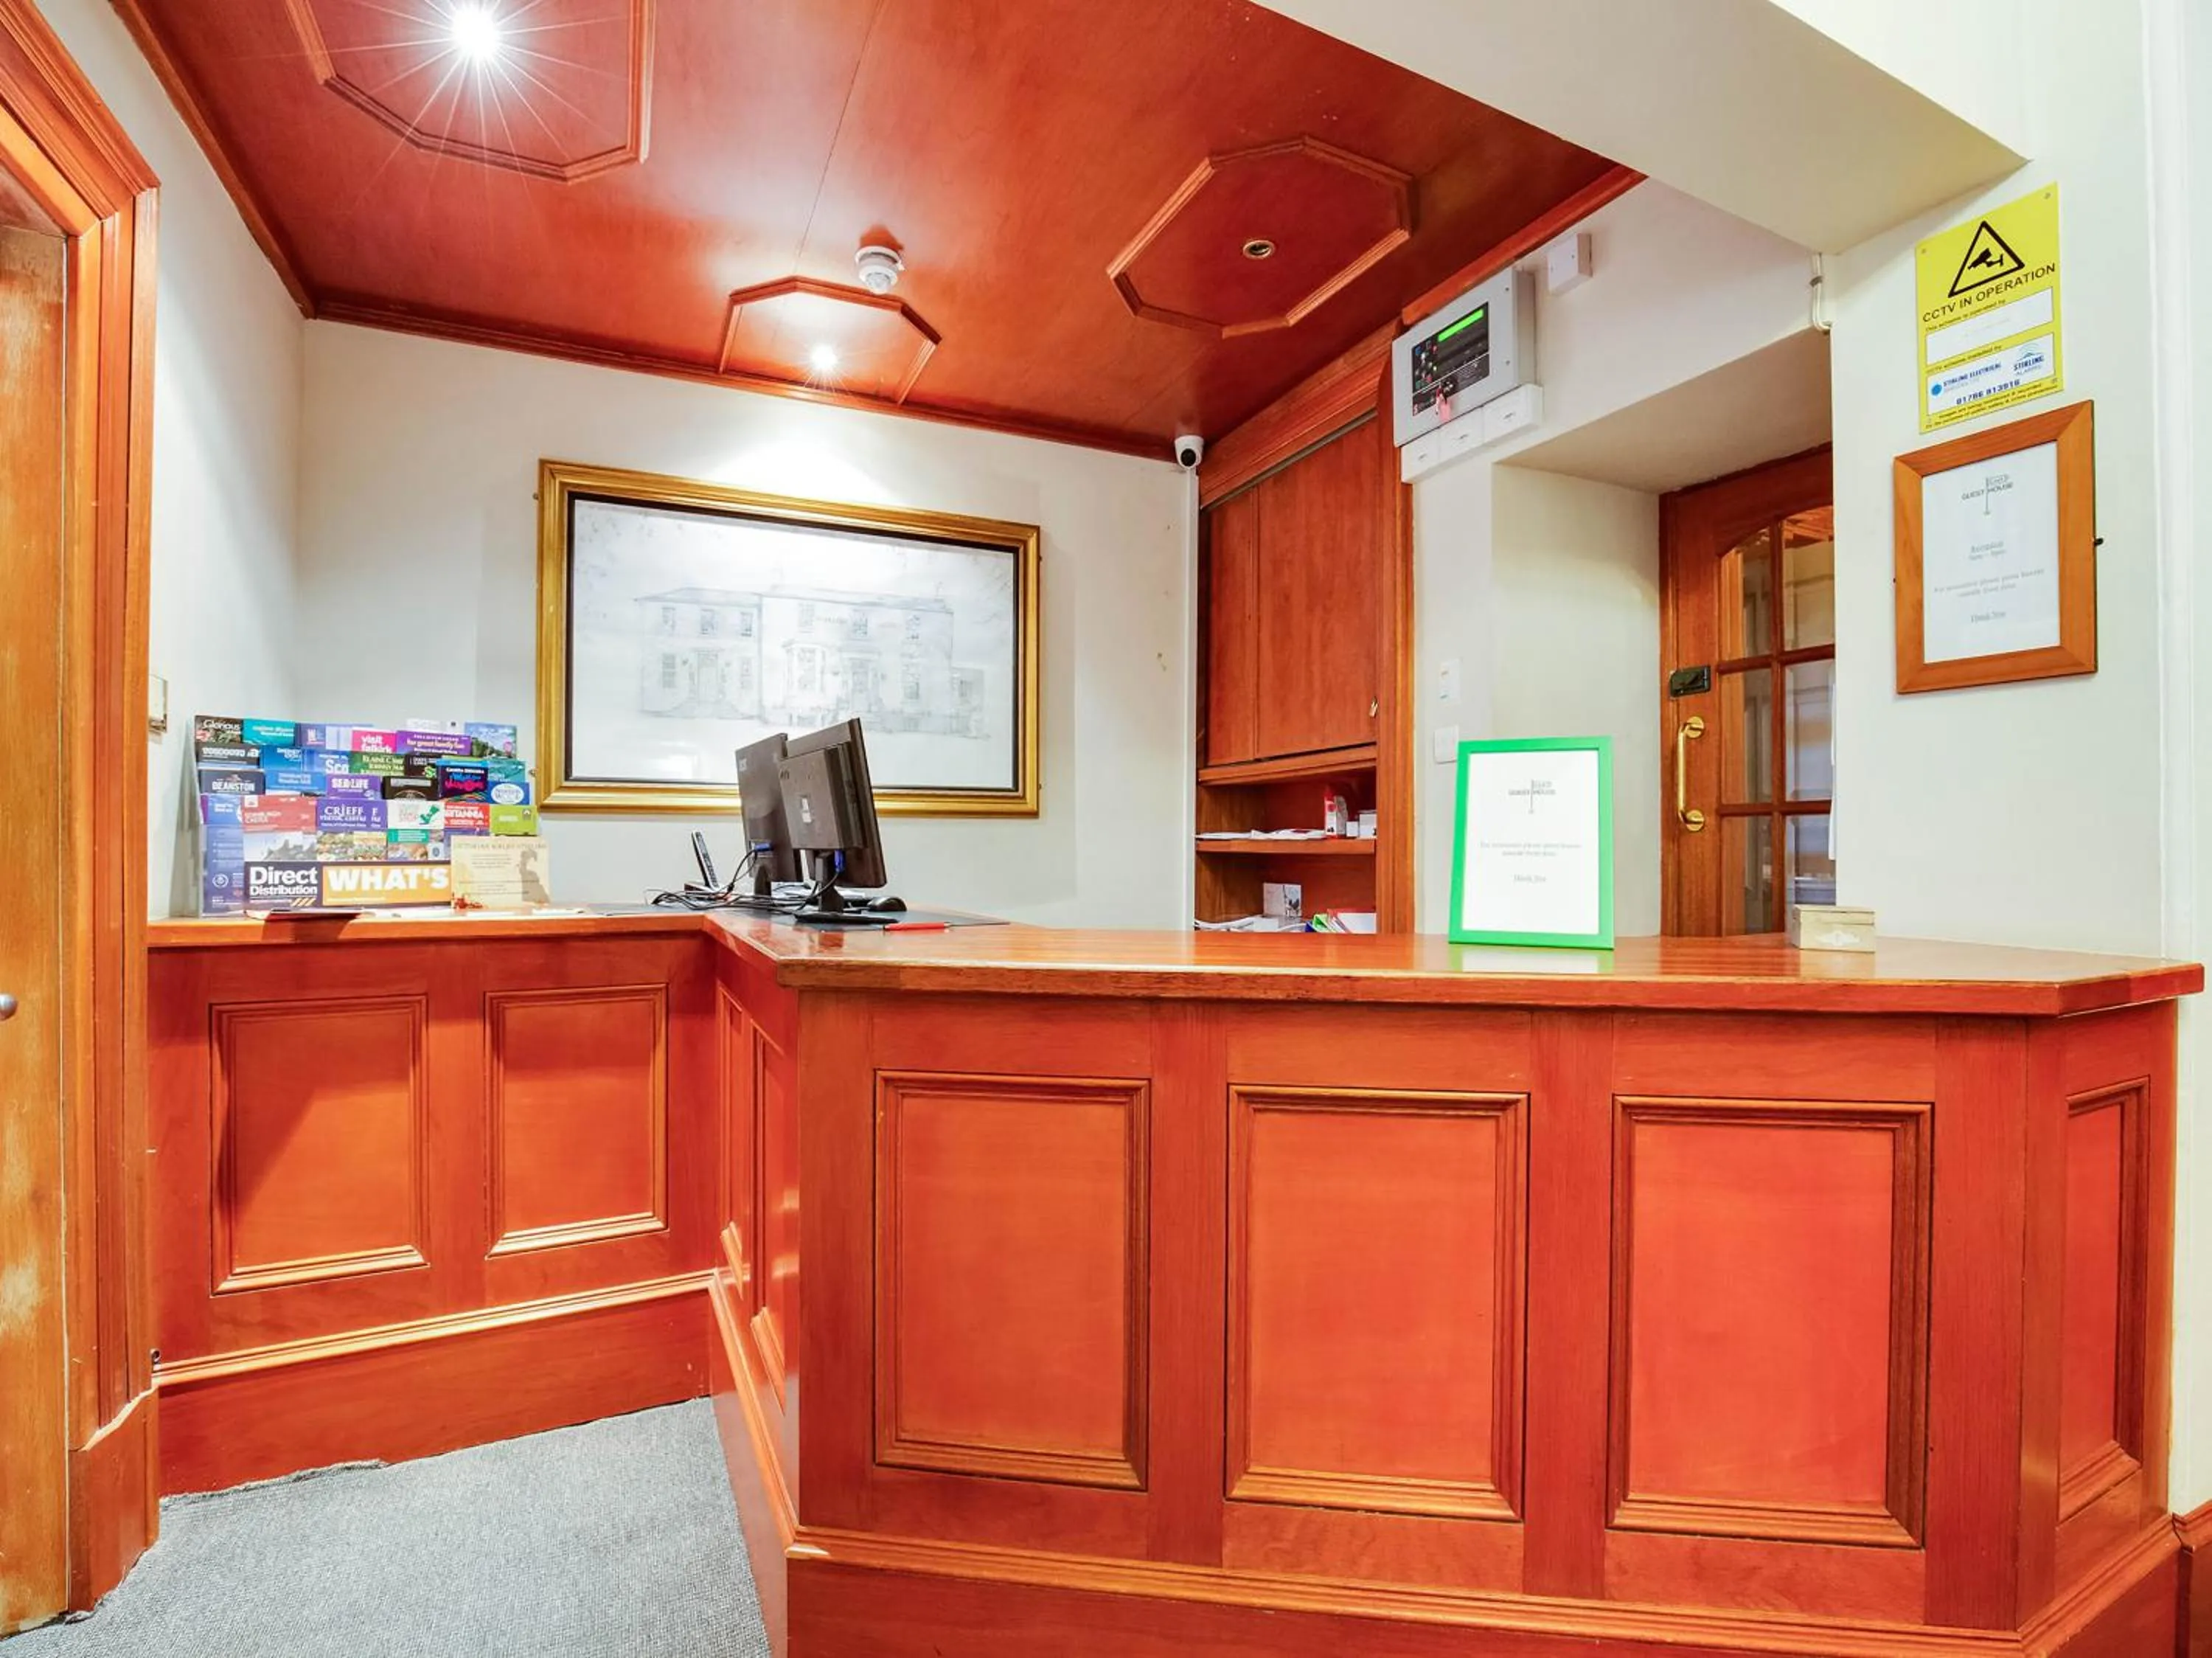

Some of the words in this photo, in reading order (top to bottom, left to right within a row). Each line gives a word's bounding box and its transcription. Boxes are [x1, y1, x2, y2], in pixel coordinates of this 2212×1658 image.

[1922, 304, 1955, 323] CCTV
[1959, 297, 1972, 308] IN
[1975, 263, 2054, 302] OPERATION
[2014, 355, 2044, 370] STIRLING
[361, 735, 383, 744] visit
[351, 778, 369, 788] LIFE
[324, 804, 364, 816] CRIEFF
[249, 867, 318, 885] Direct
[328, 868, 448, 892] WHAT'S
[249, 886, 318, 896] Distribution
